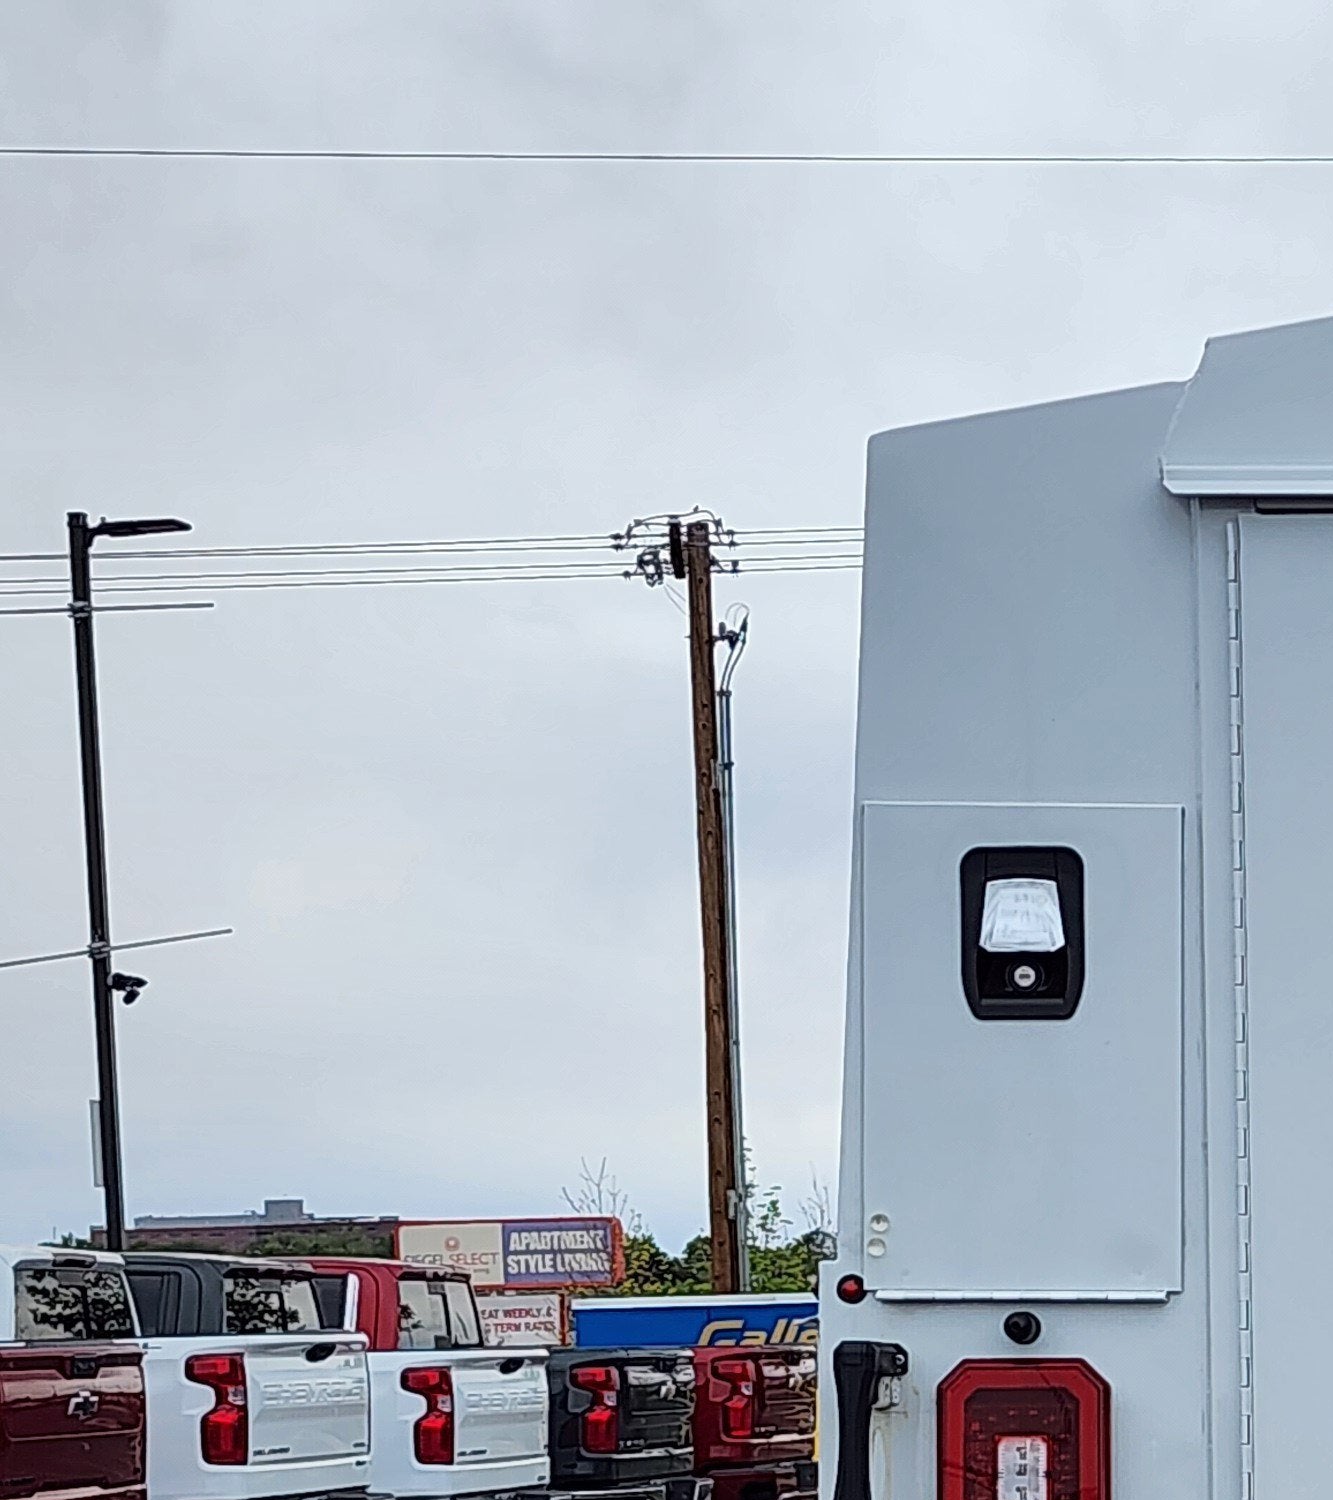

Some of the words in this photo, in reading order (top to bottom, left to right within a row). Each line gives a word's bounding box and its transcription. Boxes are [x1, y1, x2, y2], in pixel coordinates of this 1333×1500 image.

[509, 1230, 604, 1251] APARTMENT
[449, 1253, 499, 1265] SELECT
[507, 1253, 554, 1274] STYLE
[493, 1322, 521, 1333] TERM
